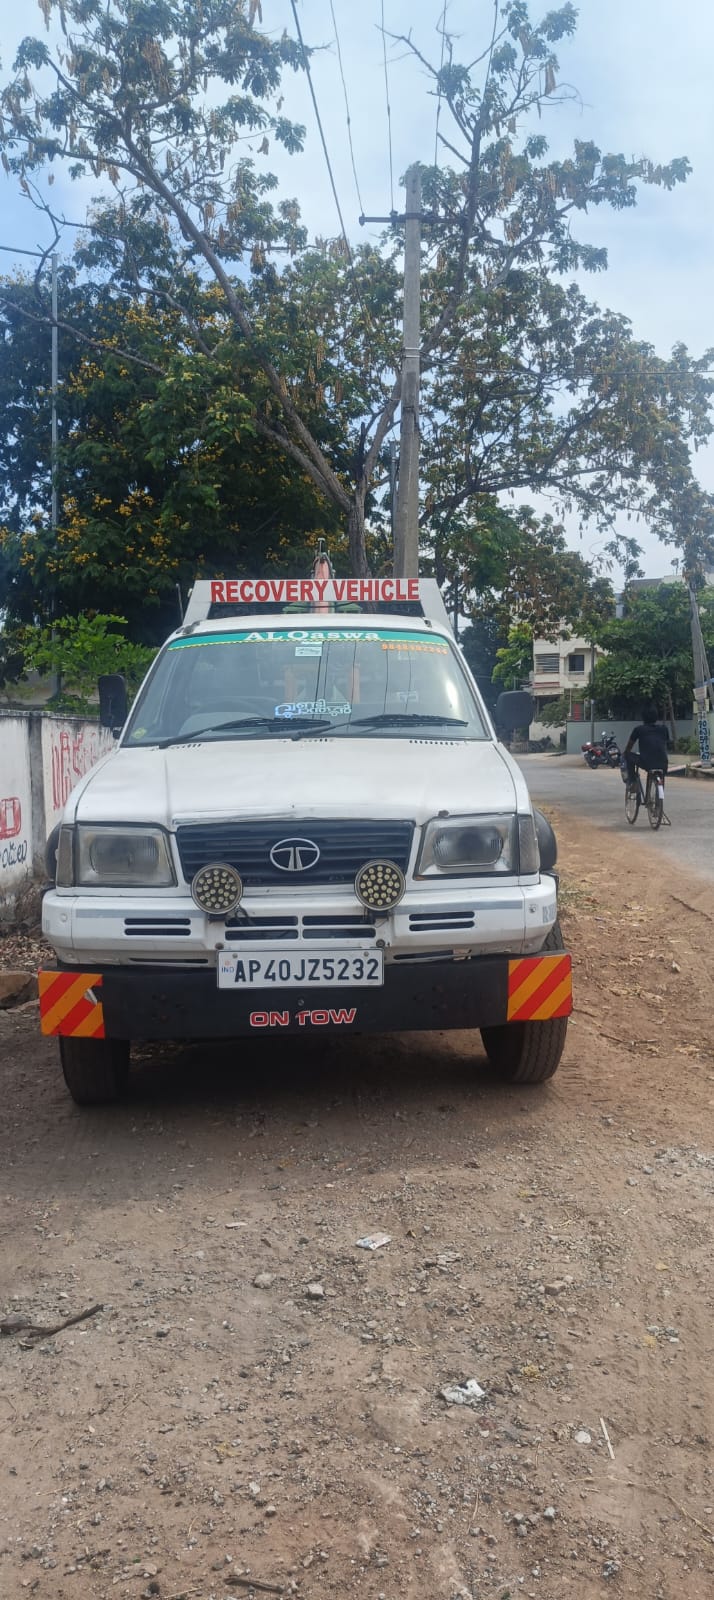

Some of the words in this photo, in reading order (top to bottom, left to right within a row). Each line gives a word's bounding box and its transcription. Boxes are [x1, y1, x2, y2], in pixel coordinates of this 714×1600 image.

[210, 580, 329, 602] RECOVERY
[332, 578, 420, 601] VEHICLE
[245, 631, 283, 641] AL
[288, 630, 380, 641] Qaswa
[234, 958, 379, 982] AP40JZ5232
[250, 1011, 289, 1027] ON
[295, 1008, 357, 1025] TOW
